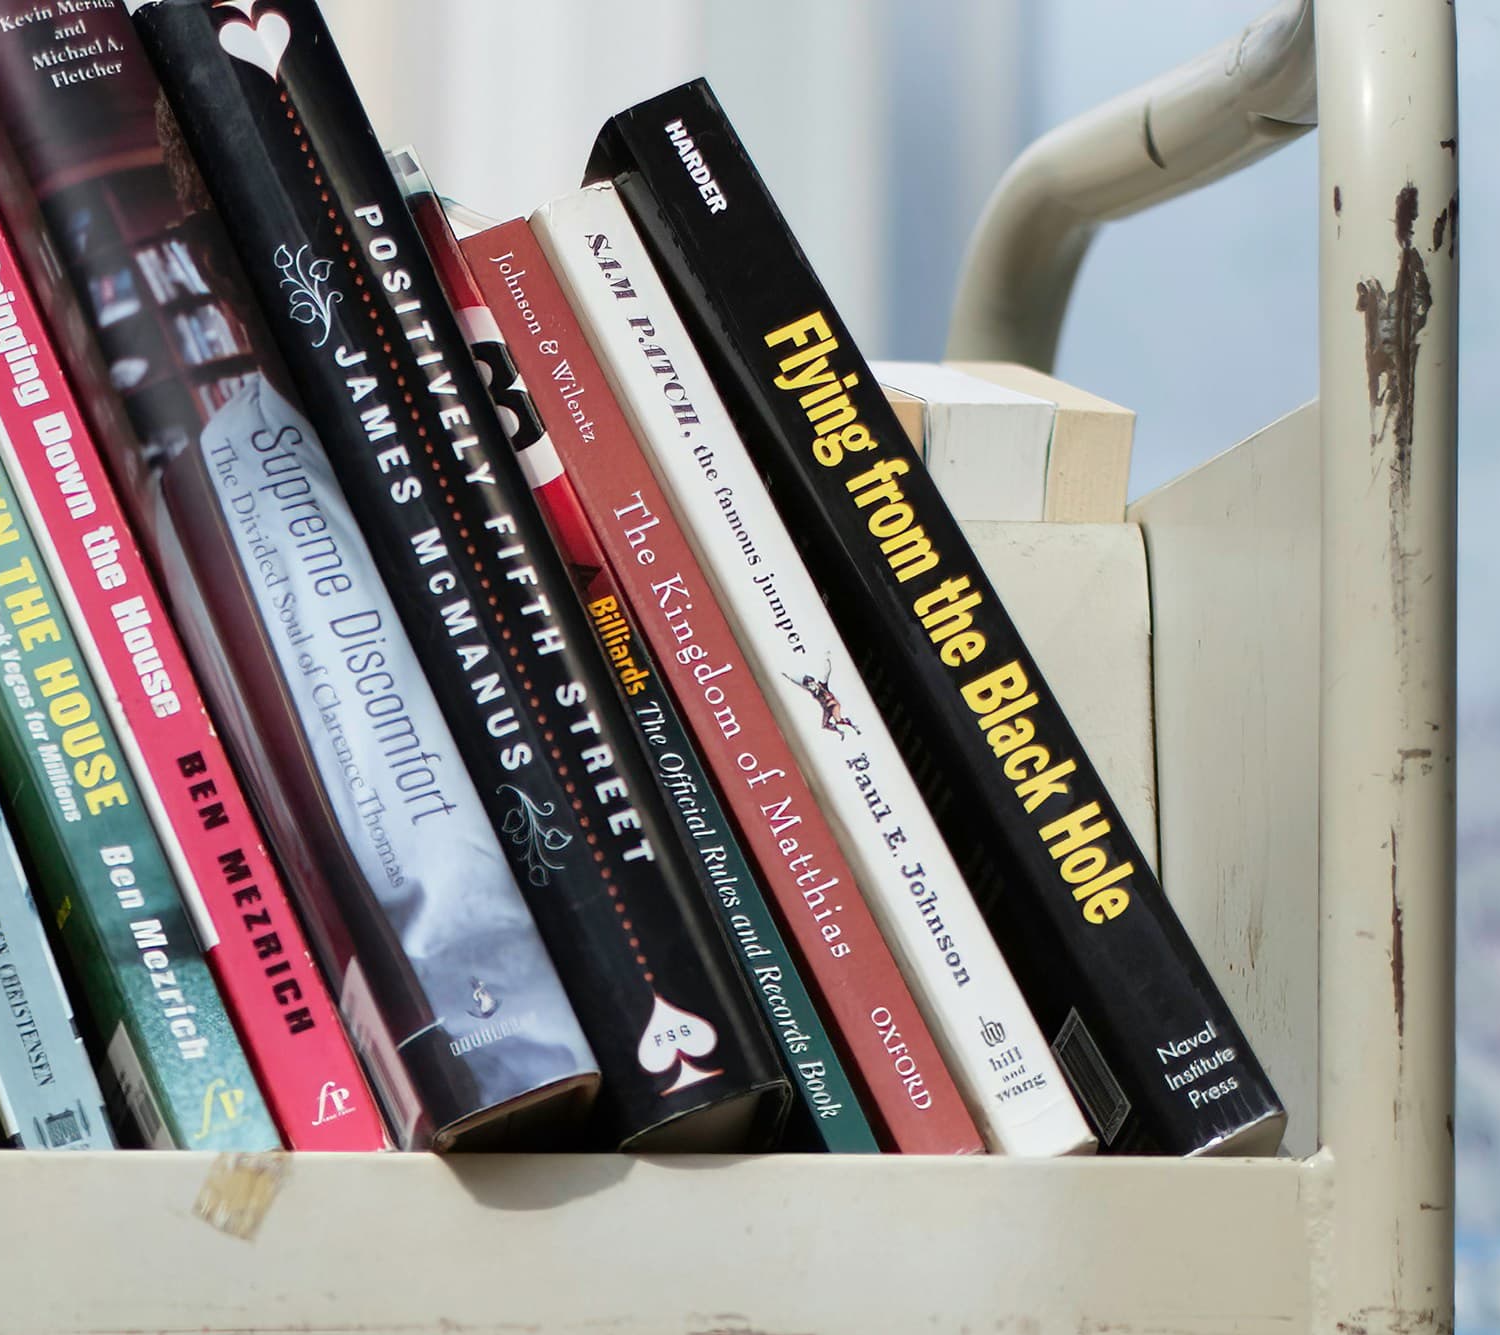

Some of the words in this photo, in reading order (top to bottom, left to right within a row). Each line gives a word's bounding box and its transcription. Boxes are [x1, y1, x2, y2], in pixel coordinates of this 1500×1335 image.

[664, 118, 728, 215] HARDER
[333, 344, 423, 505] JAMES
[32, 410, 97, 520] Down
[81, 525, 128, 591] the
[110, 595, 182, 719] House
[353, 204, 497, 494] POSITIVELY
[483, 508, 567, 656] FIFTH
[554, 673, 655, 862] STREET
[612, 489, 661, 566] The
[250, 424, 353, 597] Supreme
[328, 608, 458, 826] Discomfort
[589, 594, 650, 696] Billiards
[649, 571, 742, 741] Kingdom
[763, 309, 879, 468] Flying
[844, 457, 941, 584] from
[912, 574, 987, 668] the
[959, 659, 1078, 815] Black
[1037, 800, 1135, 925] Hole
[33, 657, 130, 816] HOUSE
[736, 751, 787, 790] of
[99, 844, 146, 910] Ben
[128, 918, 207, 1059] Mezrich
[176, 749, 230, 831] BEN
[217, 847, 316, 1036] MEZRICH
[635, 700, 668, 746] The
[658, 752, 717, 840] Official
[699, 844, 741, 909] Rules
[730, 914, 773, 960] and
[753, 965, 812, 1054] Records
[796, 1060, 843, 1120] Book
[759, 795, 852, 959] Matthias
[870, 1006, 933, 1110] OXFORD
[1156, 1020, 1217, 1065] Naval
[1164, 1047, 1236, 1091] Institute
[1187, 1076, 1239, 1110] Press
